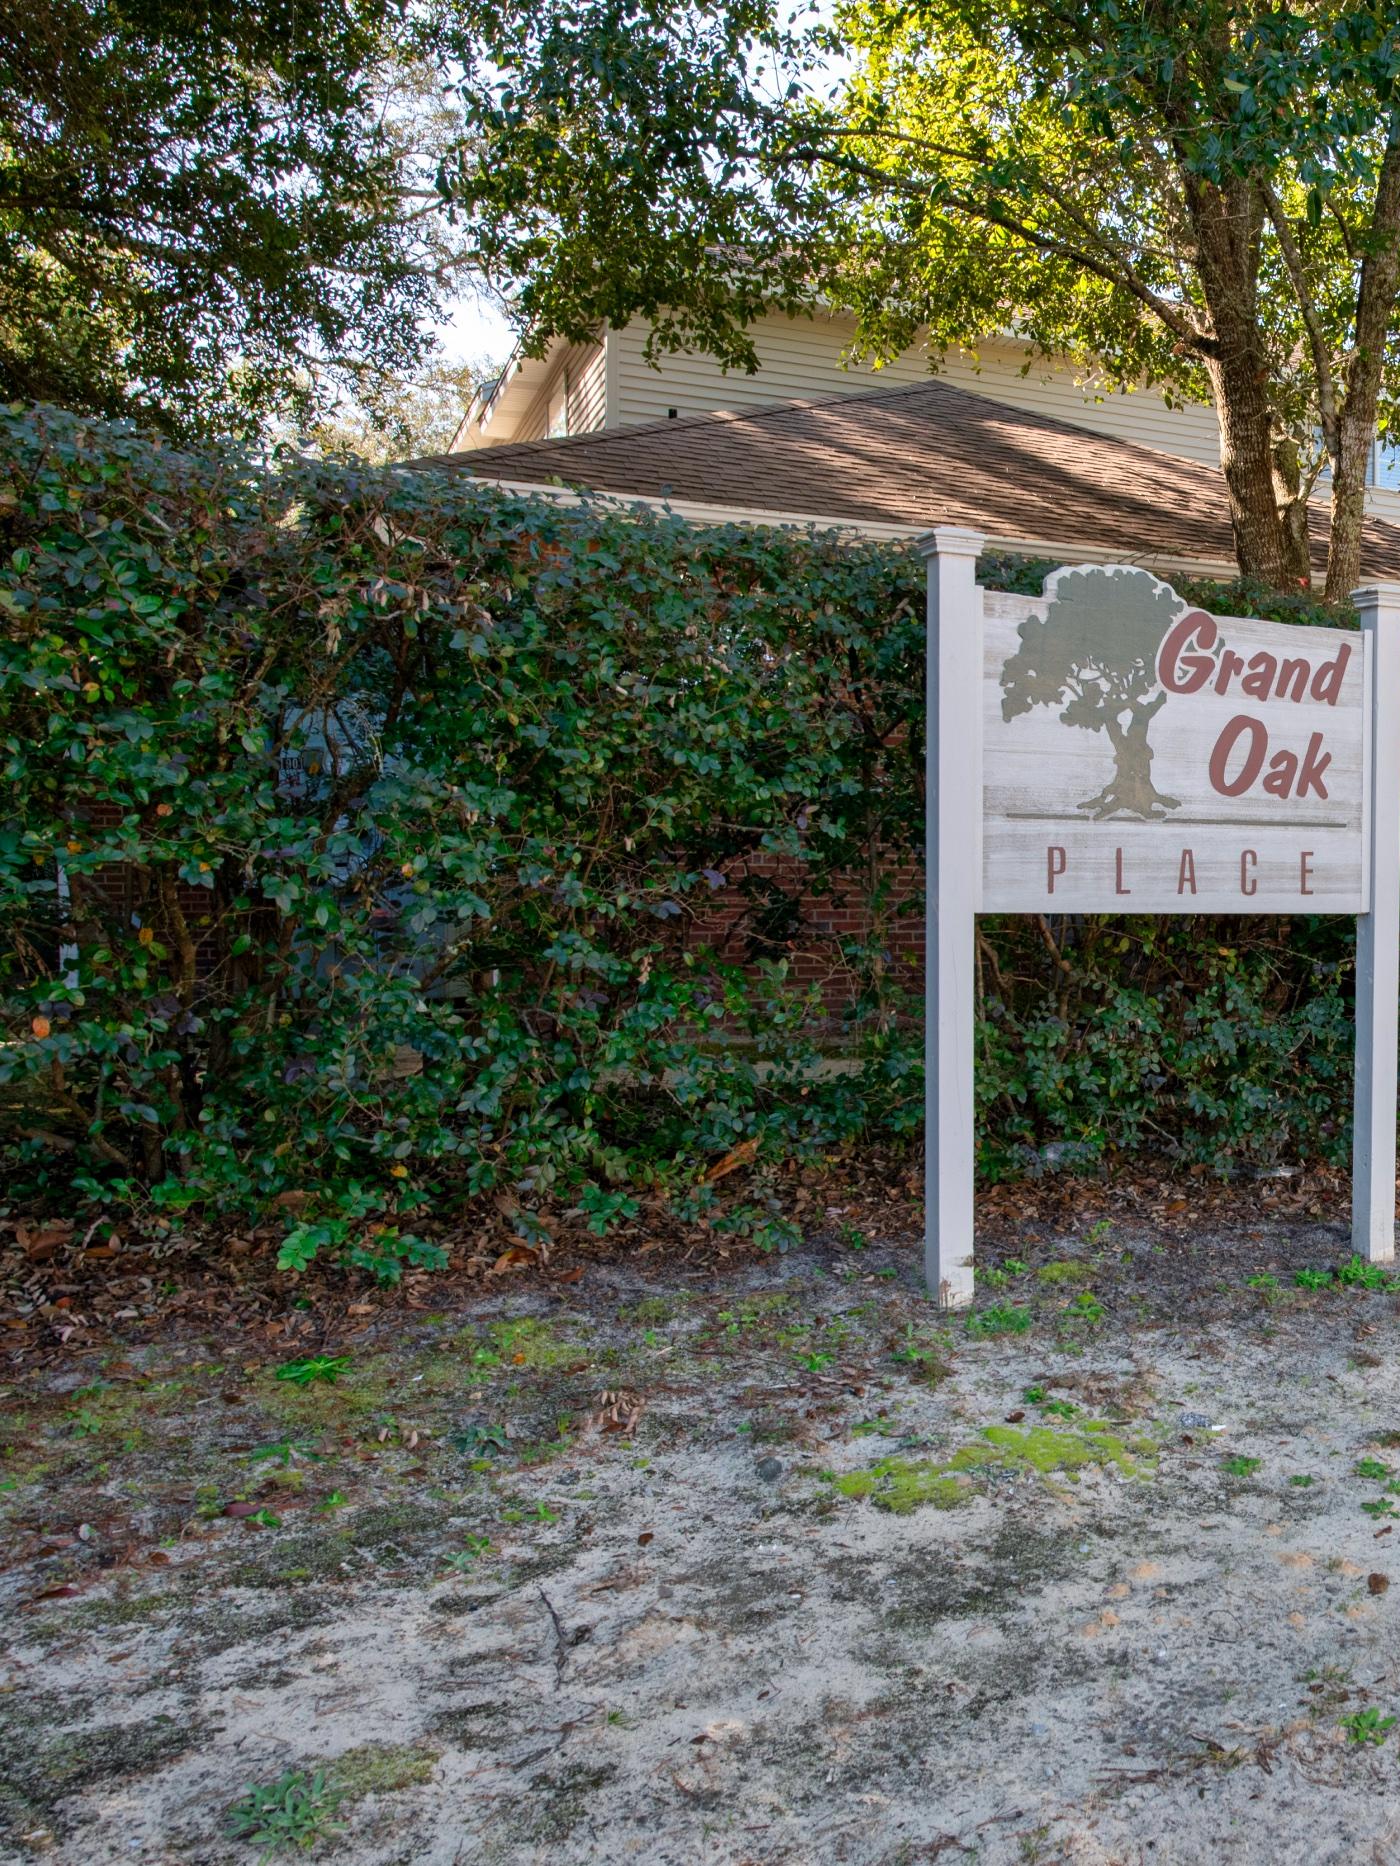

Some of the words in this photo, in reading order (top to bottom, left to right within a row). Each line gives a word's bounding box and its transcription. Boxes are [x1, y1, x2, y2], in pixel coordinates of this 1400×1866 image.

[1158, 611, 1352, 706] Grand
[1209, 715, 1332, 800] Oak
[1046, 846, 1315, 896] PLACE
